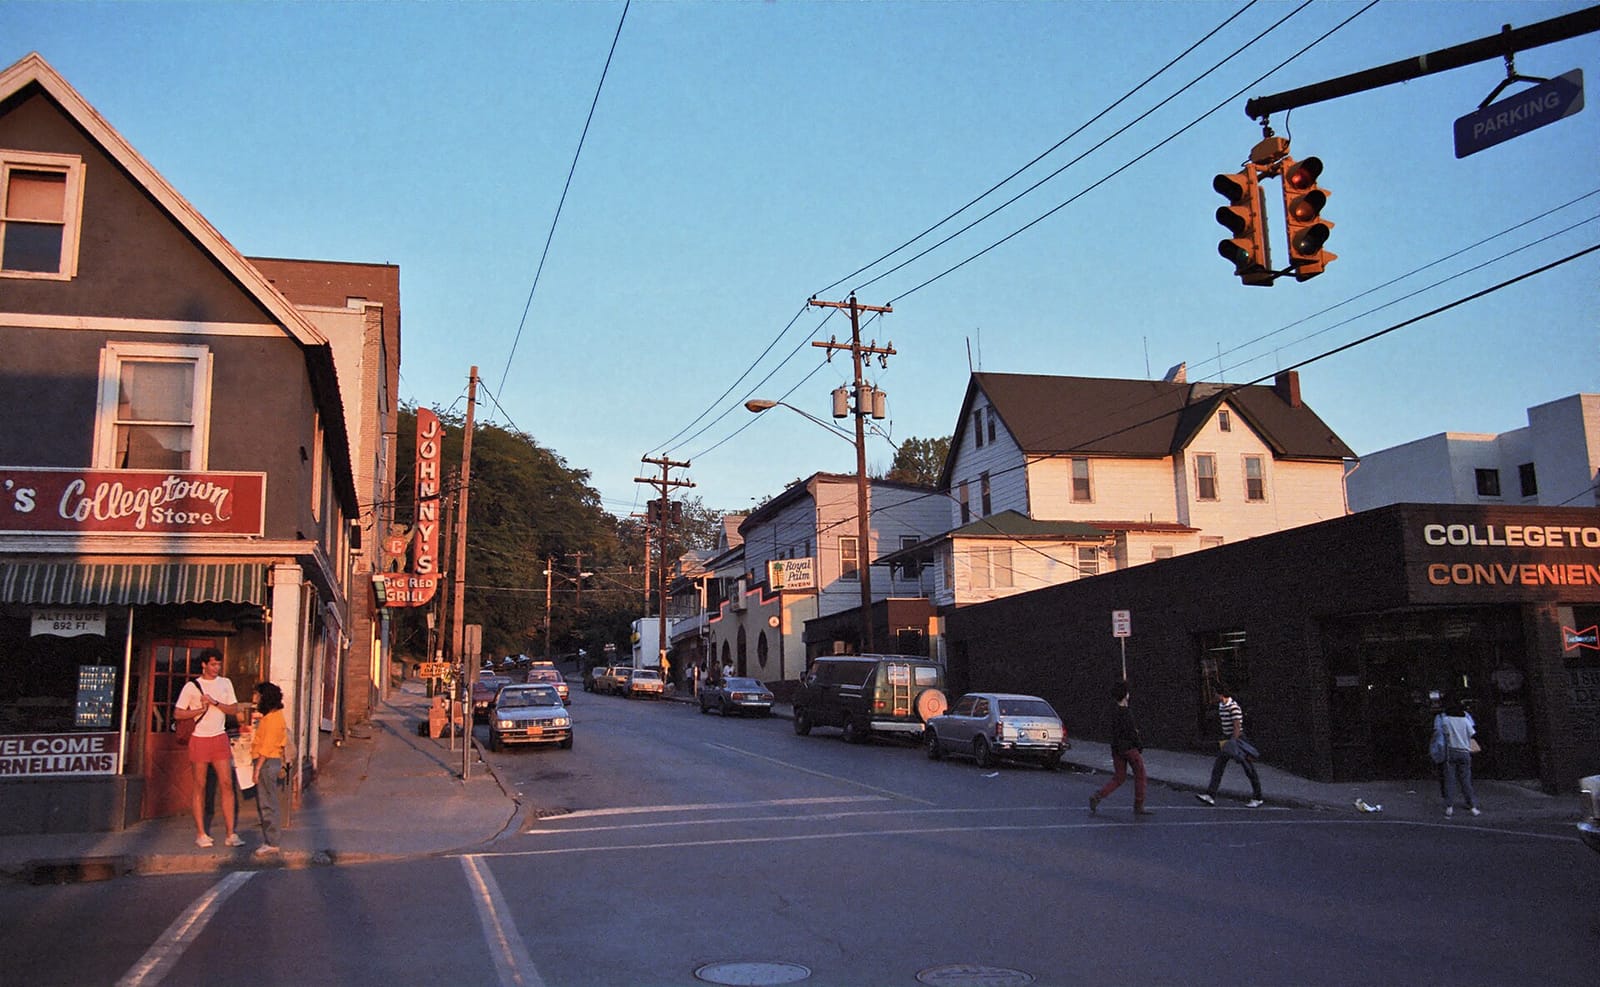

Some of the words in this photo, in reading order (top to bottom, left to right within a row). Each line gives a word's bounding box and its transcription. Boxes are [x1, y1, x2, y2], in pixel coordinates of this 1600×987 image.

[1473, 91, 1560, 140] PARKING
[58, 475, 231, 529] Collegetown
[416, 421, 437, 575] JOHNNY'S
[151, 506, 213, 526] Store
[1424, 524, 1600, 547] COLLEGETO
[785, 560, 811, 573] Royal
[384, 576, 405, 588] BIG
[409, 577, 433, 588] RED
[787, 572, 810, 581] Palm
[386, 589, 424, 602] GRILL
[38, 612, 100, 621] ALTITUDE
[53, 622, 72, 631] 892
[0, 738, 104, 754] ELCOME
